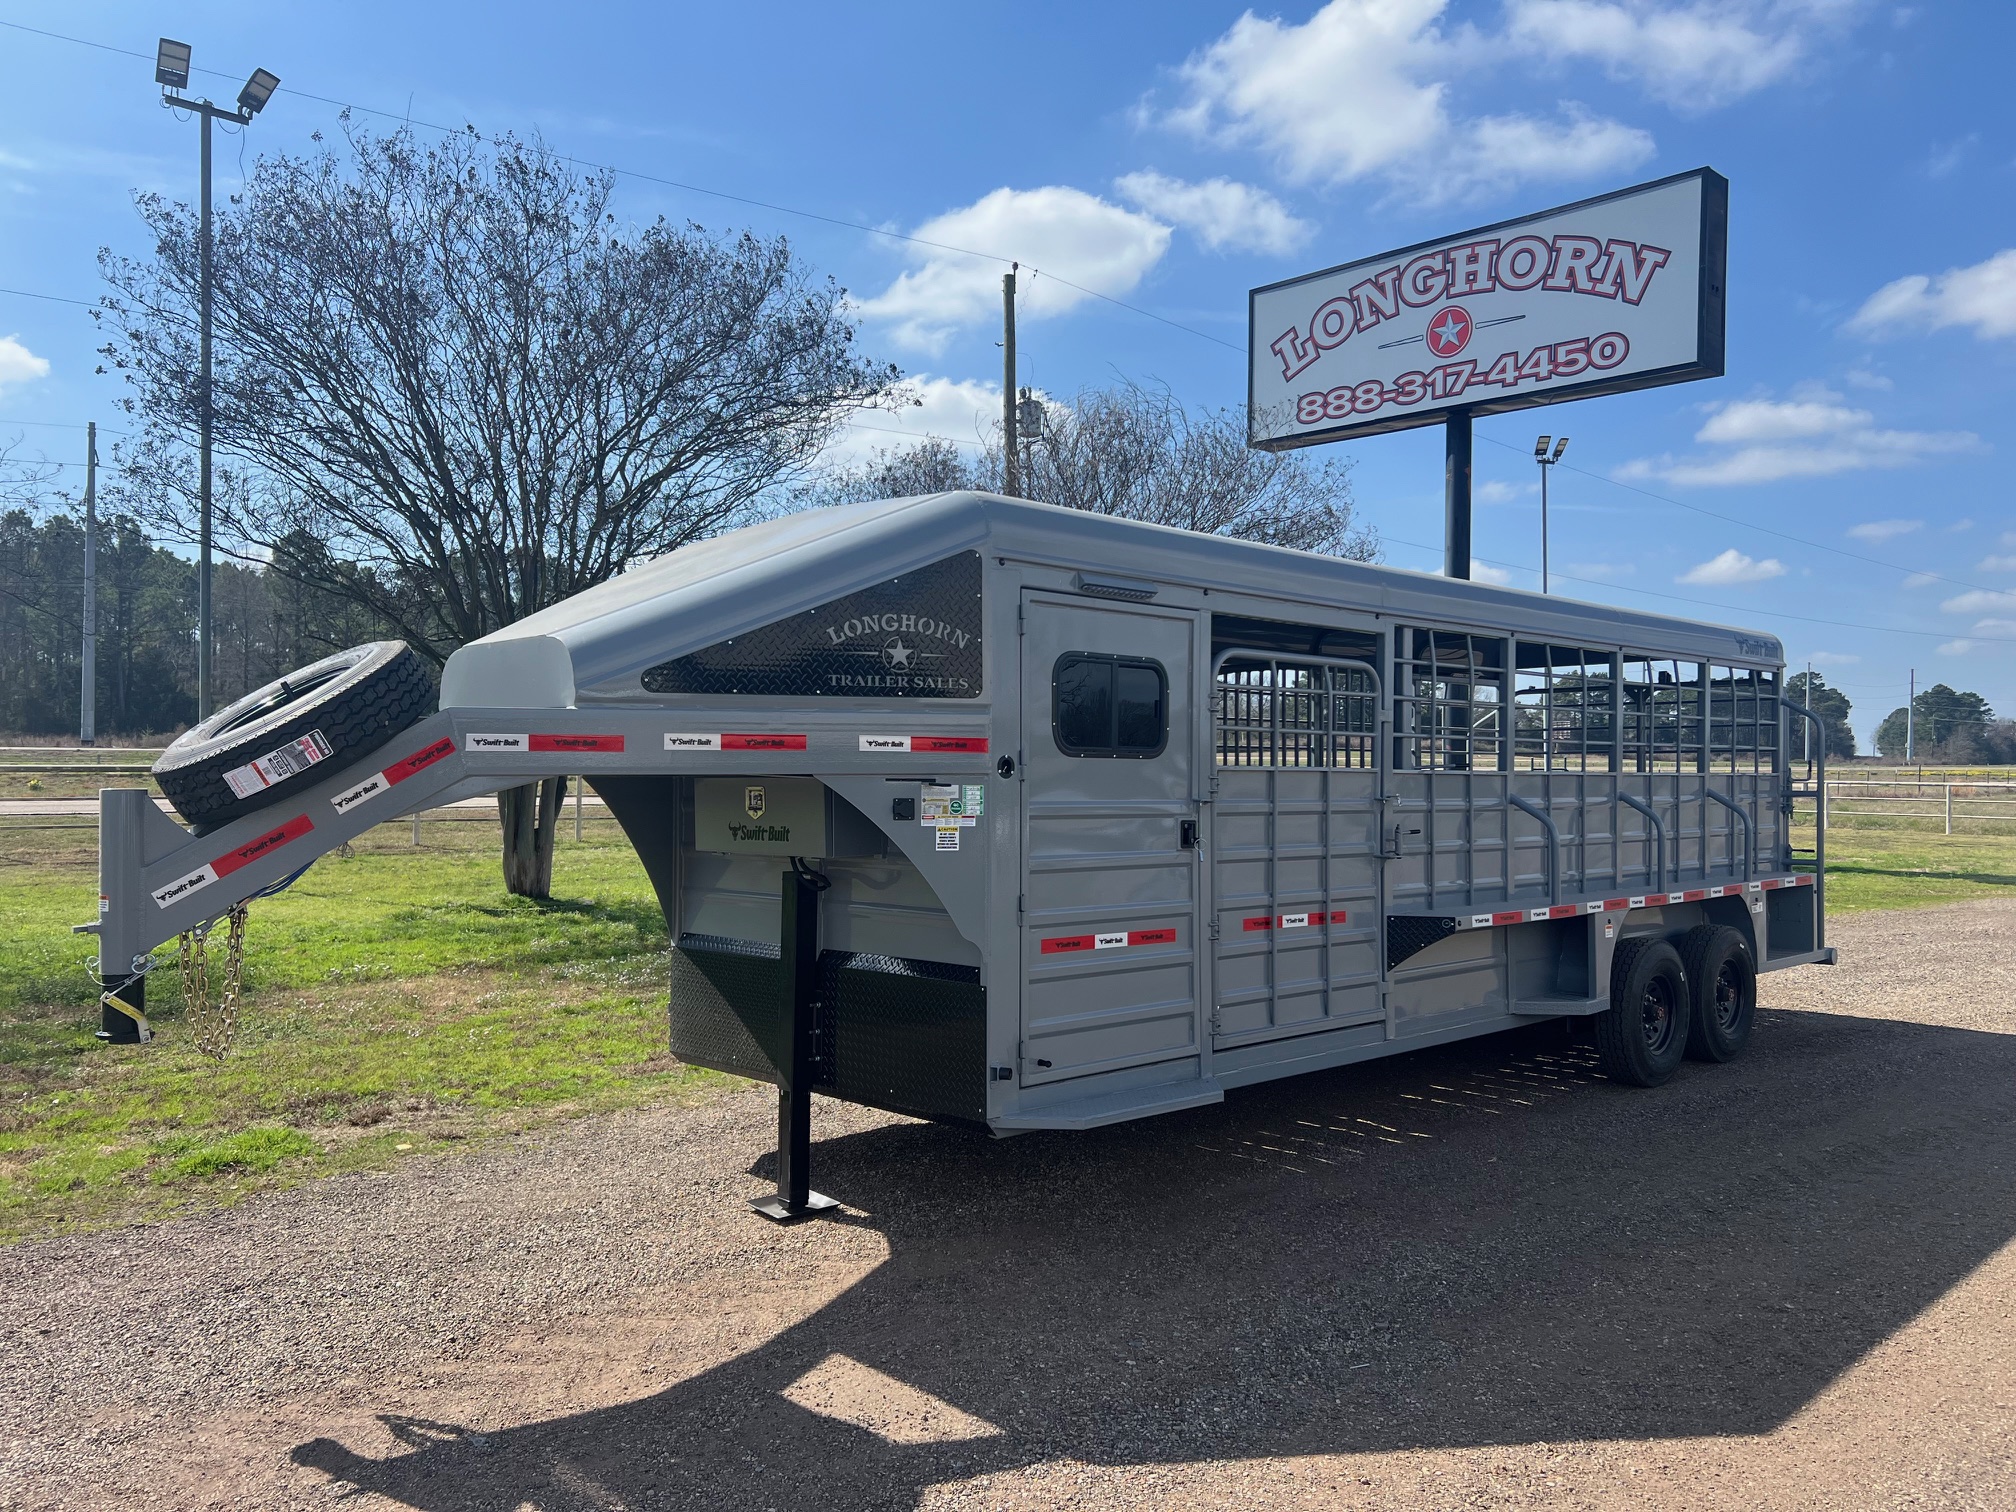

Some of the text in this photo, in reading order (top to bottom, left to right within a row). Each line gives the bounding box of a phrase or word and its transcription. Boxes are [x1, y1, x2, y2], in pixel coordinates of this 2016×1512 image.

[1270, 234, 1672, 383] LONGHORN
[1296, 332, 1630, 424] 888-317-4450
[826, 613, 971, 650] LONGHORN
[828, 674, 969, 690] TRAILER SALES
[416, 741, 451, 765] Swift Built
[482, 738, 520, 747] Swift Built
[343, 780, 379, 806] Swift Built
[248, 831, 286, 857] Swift Built
[740, 824, 790, 842] Swift Built
[166, 873, 206, 899] Swift Built
